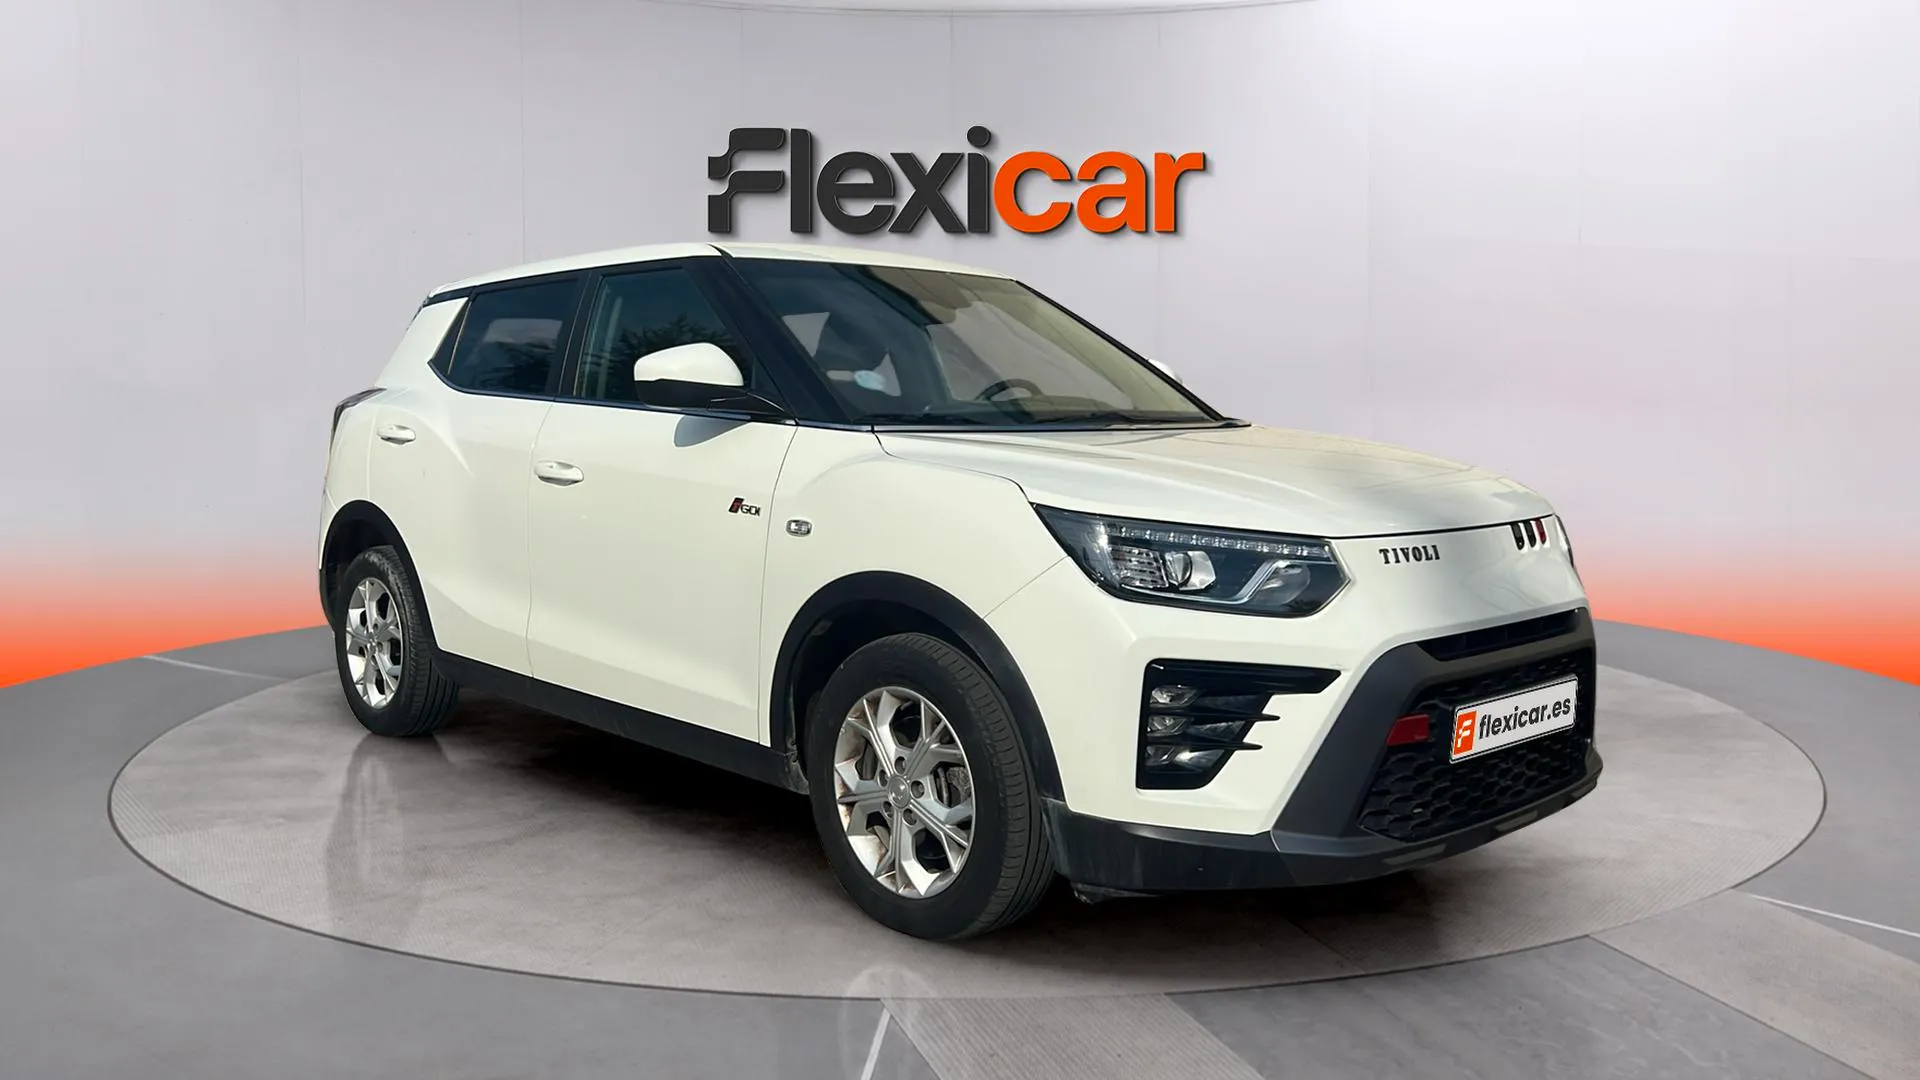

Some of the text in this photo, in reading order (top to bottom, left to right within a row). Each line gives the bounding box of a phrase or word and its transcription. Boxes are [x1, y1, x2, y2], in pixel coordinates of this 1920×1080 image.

[708, 126, 1205, 234] Flexicar
[1379, 544, 1441, 565] TIVOLI
[1478, 697, 1572, 740] flexicar.es
